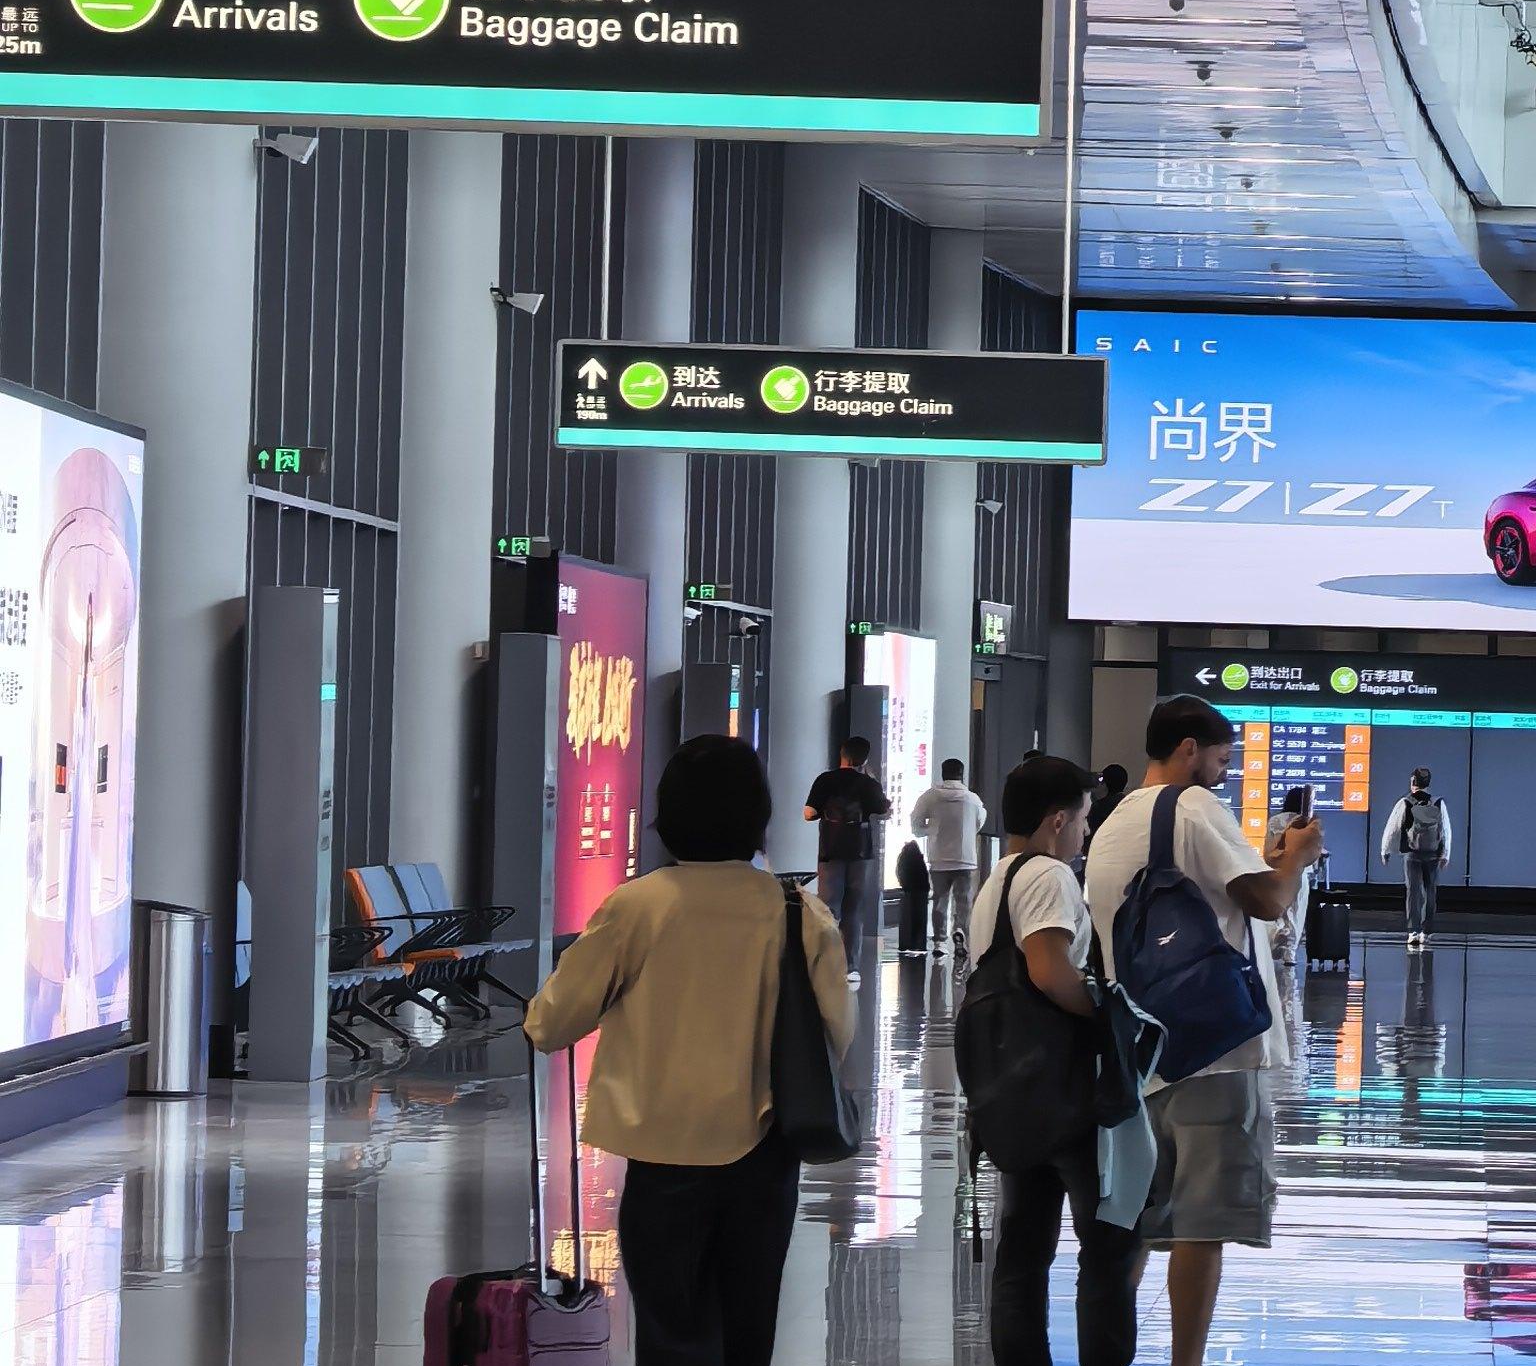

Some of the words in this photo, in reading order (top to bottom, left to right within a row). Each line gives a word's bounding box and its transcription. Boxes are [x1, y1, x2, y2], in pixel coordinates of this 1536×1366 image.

[1, 23, 18, 32] UP
[21, 23, 38, 33] TO
[460, 5, 622, 47] Baggage
[634, 11, 738, 45] Claim
[1096, 337, 1219, 353] SAIC
[672, 366, 721, 389] 到达
[814, 370, 910, 395] 行李提取
[671, 392, 745, 409] Arrivals
[814, 396, 896, 417] Baggage
[899, 398, 954, 415] Claim
[1149, 398, 1277, 464] 尚界
[1138, 478, 1275, 513] Z7
[1250, 666, 1303, 680] 到达出口
[1360, 670, 1414, 684] 行李提取
[1250, 681, 1268, 690] Exit
[1269, 681, 1283, 691] for
[1360, 684, 1406, 696] Baggage
[1407, 685, 1438, 695] Claim
